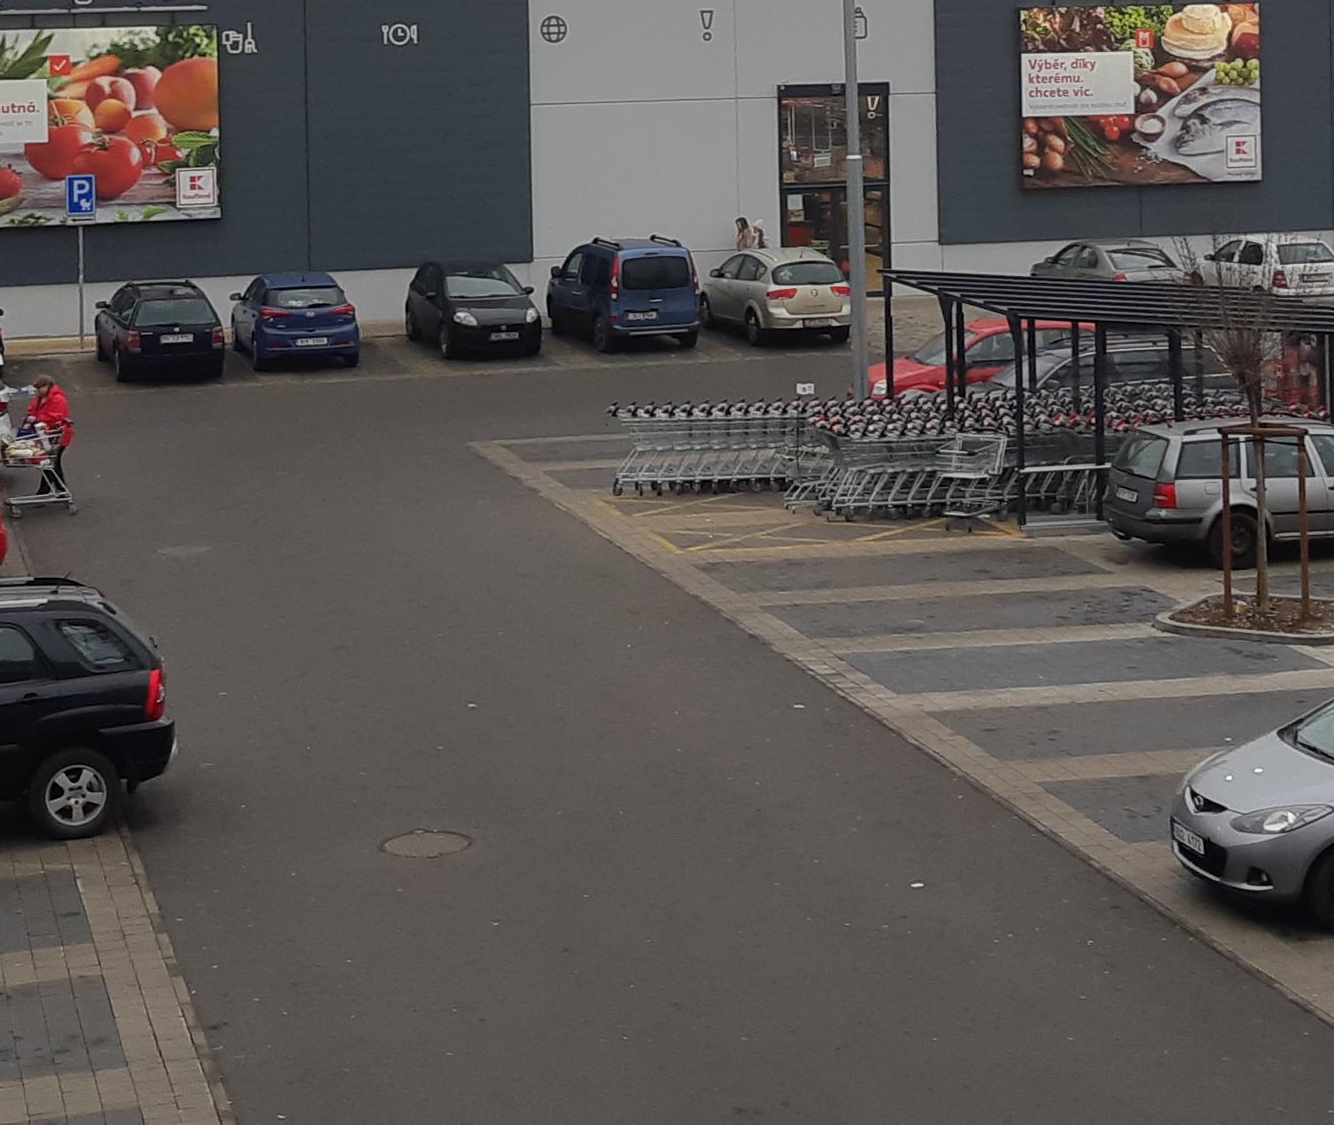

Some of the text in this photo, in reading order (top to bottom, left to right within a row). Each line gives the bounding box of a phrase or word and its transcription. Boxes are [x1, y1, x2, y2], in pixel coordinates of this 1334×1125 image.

[1028, 57, 1097, 73] Výběr, díky
[1028, 86, 1094, 98] chcete víc.
[73, 179, 91, 203] P
